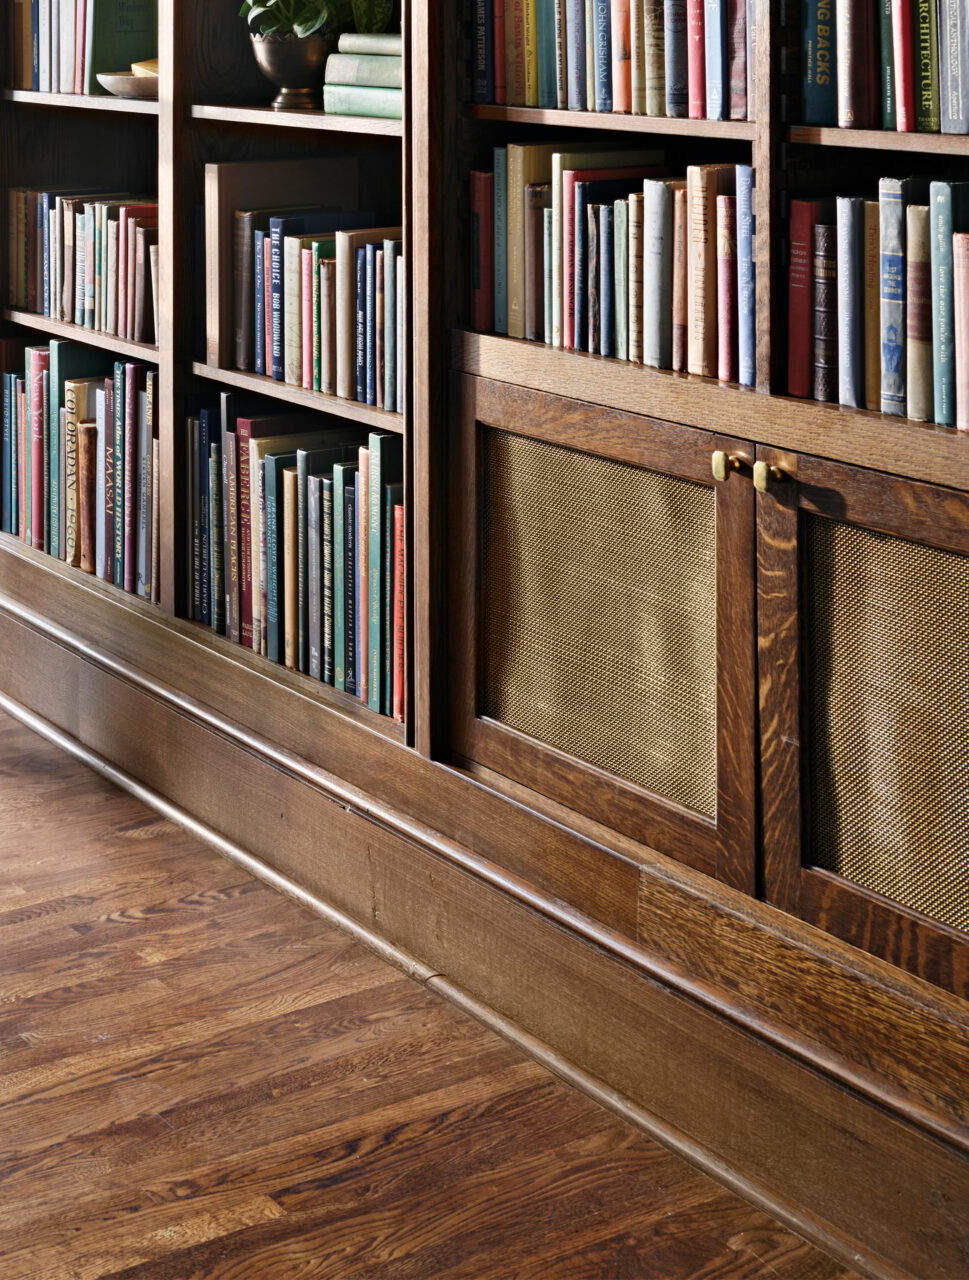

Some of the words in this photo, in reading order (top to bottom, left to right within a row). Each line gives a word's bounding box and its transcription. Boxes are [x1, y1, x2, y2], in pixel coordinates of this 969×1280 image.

[513, 1, 523, 13] of
[597, 2, 607, 31] JOHN
[475, 25, 485, 71] PATTERSON
[513, 15, 523, 48] Santa
[597, 32, 607, 82] GRISHAM
[816, 27, 831, 86] BACKS
[950, 27, 958, 76] ANTHOLOGY
[513, 51, 523, 96] Vittoria
[950, 90, 959, 120] Aperture
[740, 177, 751, 212] DANIELLE
[692, 185, 709, 244] DECIDER
[740, 215, 751, 238] STEEL
[936, 215, 945, 233] emily
[272, 227, 281, 246] THE
[936, 233, 945, 252] giffin
[272, 248, 281, 285] CHOICE
[741, 255, 751, 274] The
[937, 265, 947, 283] love
[272, 292, 281, 309] BOB
[937, 284, 947, 298] the
[937, 300, 947, 314] one
[272, 310, 281, 357] WOODWARD
[937, 315, 947, 342] you're
[937, 344, 947, 363] with
[31, 370, 43, 400] New
[31, 406, 43, 442] York
[66, 388, 76, 490] COLORADAN
[115, 445, 122, 458] of
[105, 446, 114, 515] MAASAI
[229, 470, 237, 536] AMERICAN
[370, 495, 379, 535] MOMENT
[66, 505, 76, 549] 1960
[229, 538, 237, 582] PLACES
